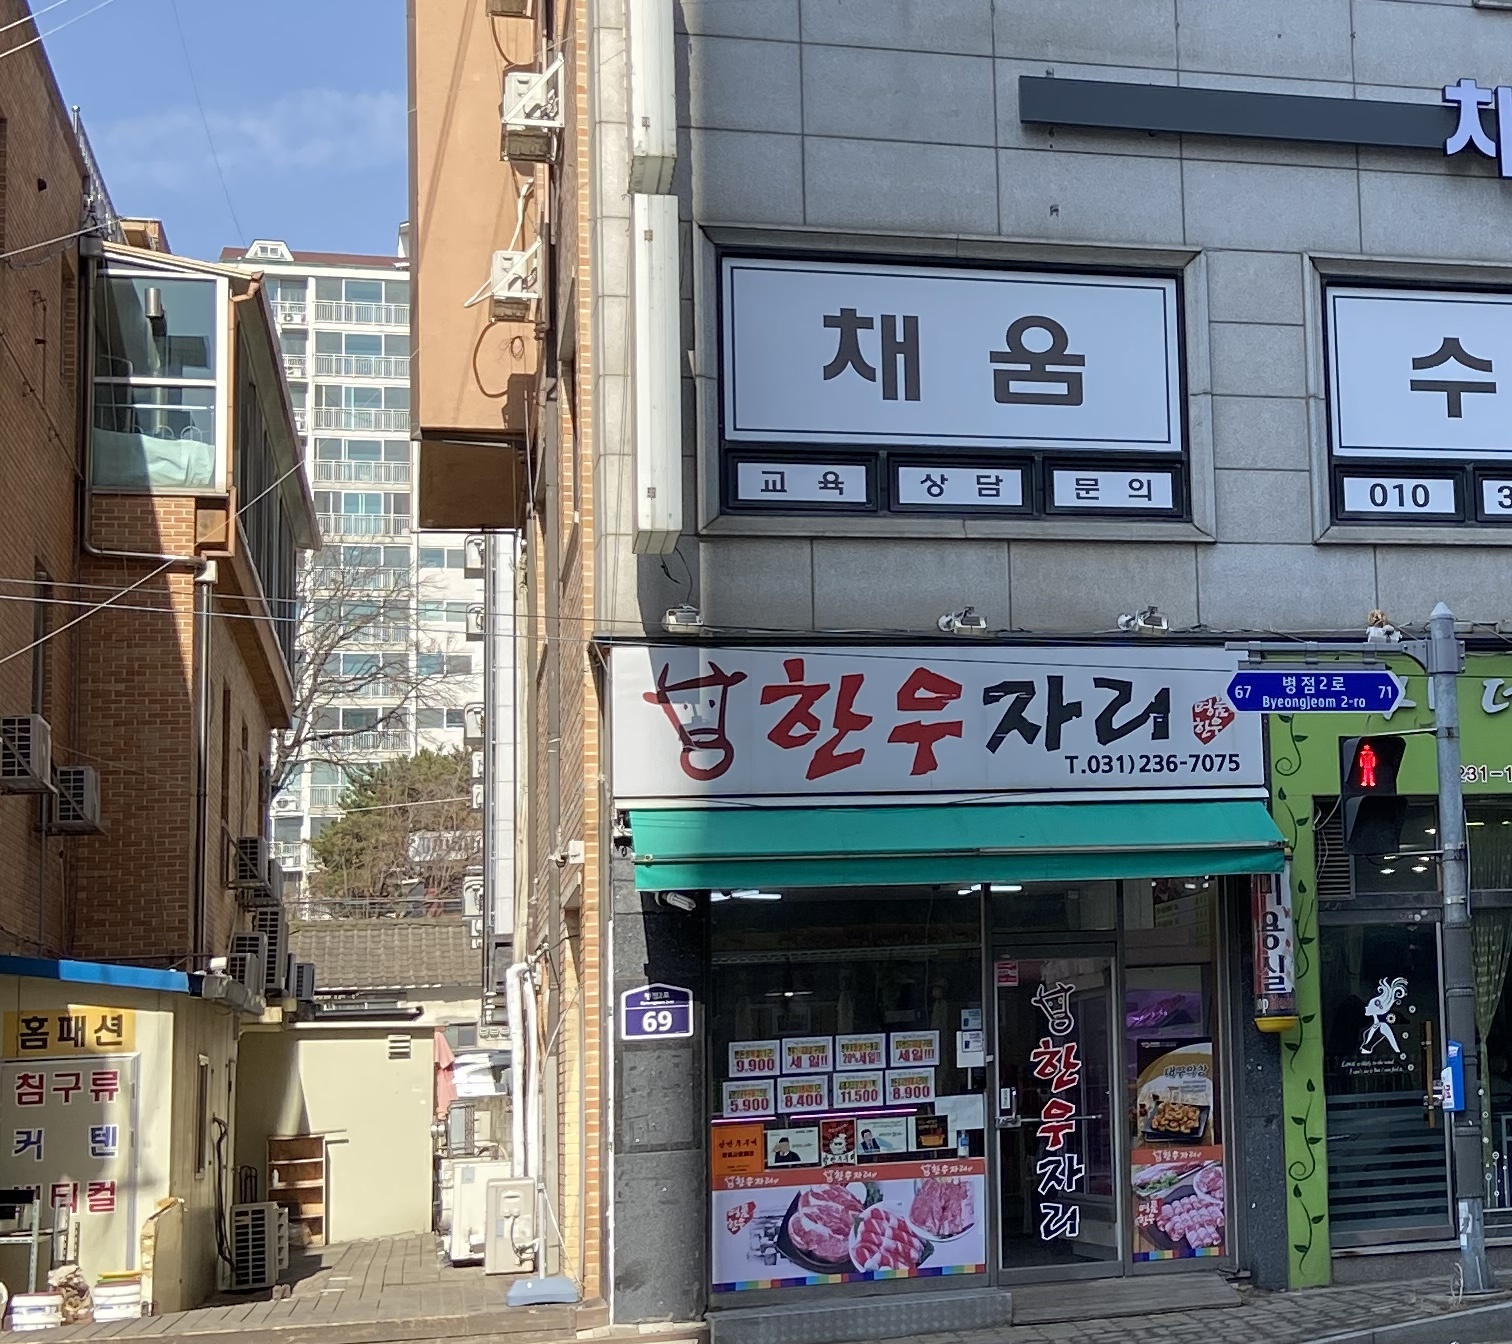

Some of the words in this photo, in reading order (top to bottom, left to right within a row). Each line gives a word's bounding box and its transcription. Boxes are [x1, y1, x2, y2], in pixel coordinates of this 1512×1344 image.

[822, 308, 1085, 406] 채움
[760, 470, 845, 496] 교육
[920, 473, 1004, 499] 상담
[1074, 477, 1153, 503] 문의
[1369, 483, 1430, 508] 010
[1234, 685, 1252, 699] 67
[1262, 695, 1336, 711] Byeongjeom
[1341, 695, 1366, 708] 2-ro
[1378, 685, 1392, 699] 71
[759, 658, 1170, 780] 한우자리
[19, 1013, 124, 1050] 홈패션
[642, 1010, 673, 1032] 69
[15, 1070, 120, 1106] 침구류
[12, 1125, 118, 1161] 커텐
[1030, 1037, 1084, 1240] 한우자리
